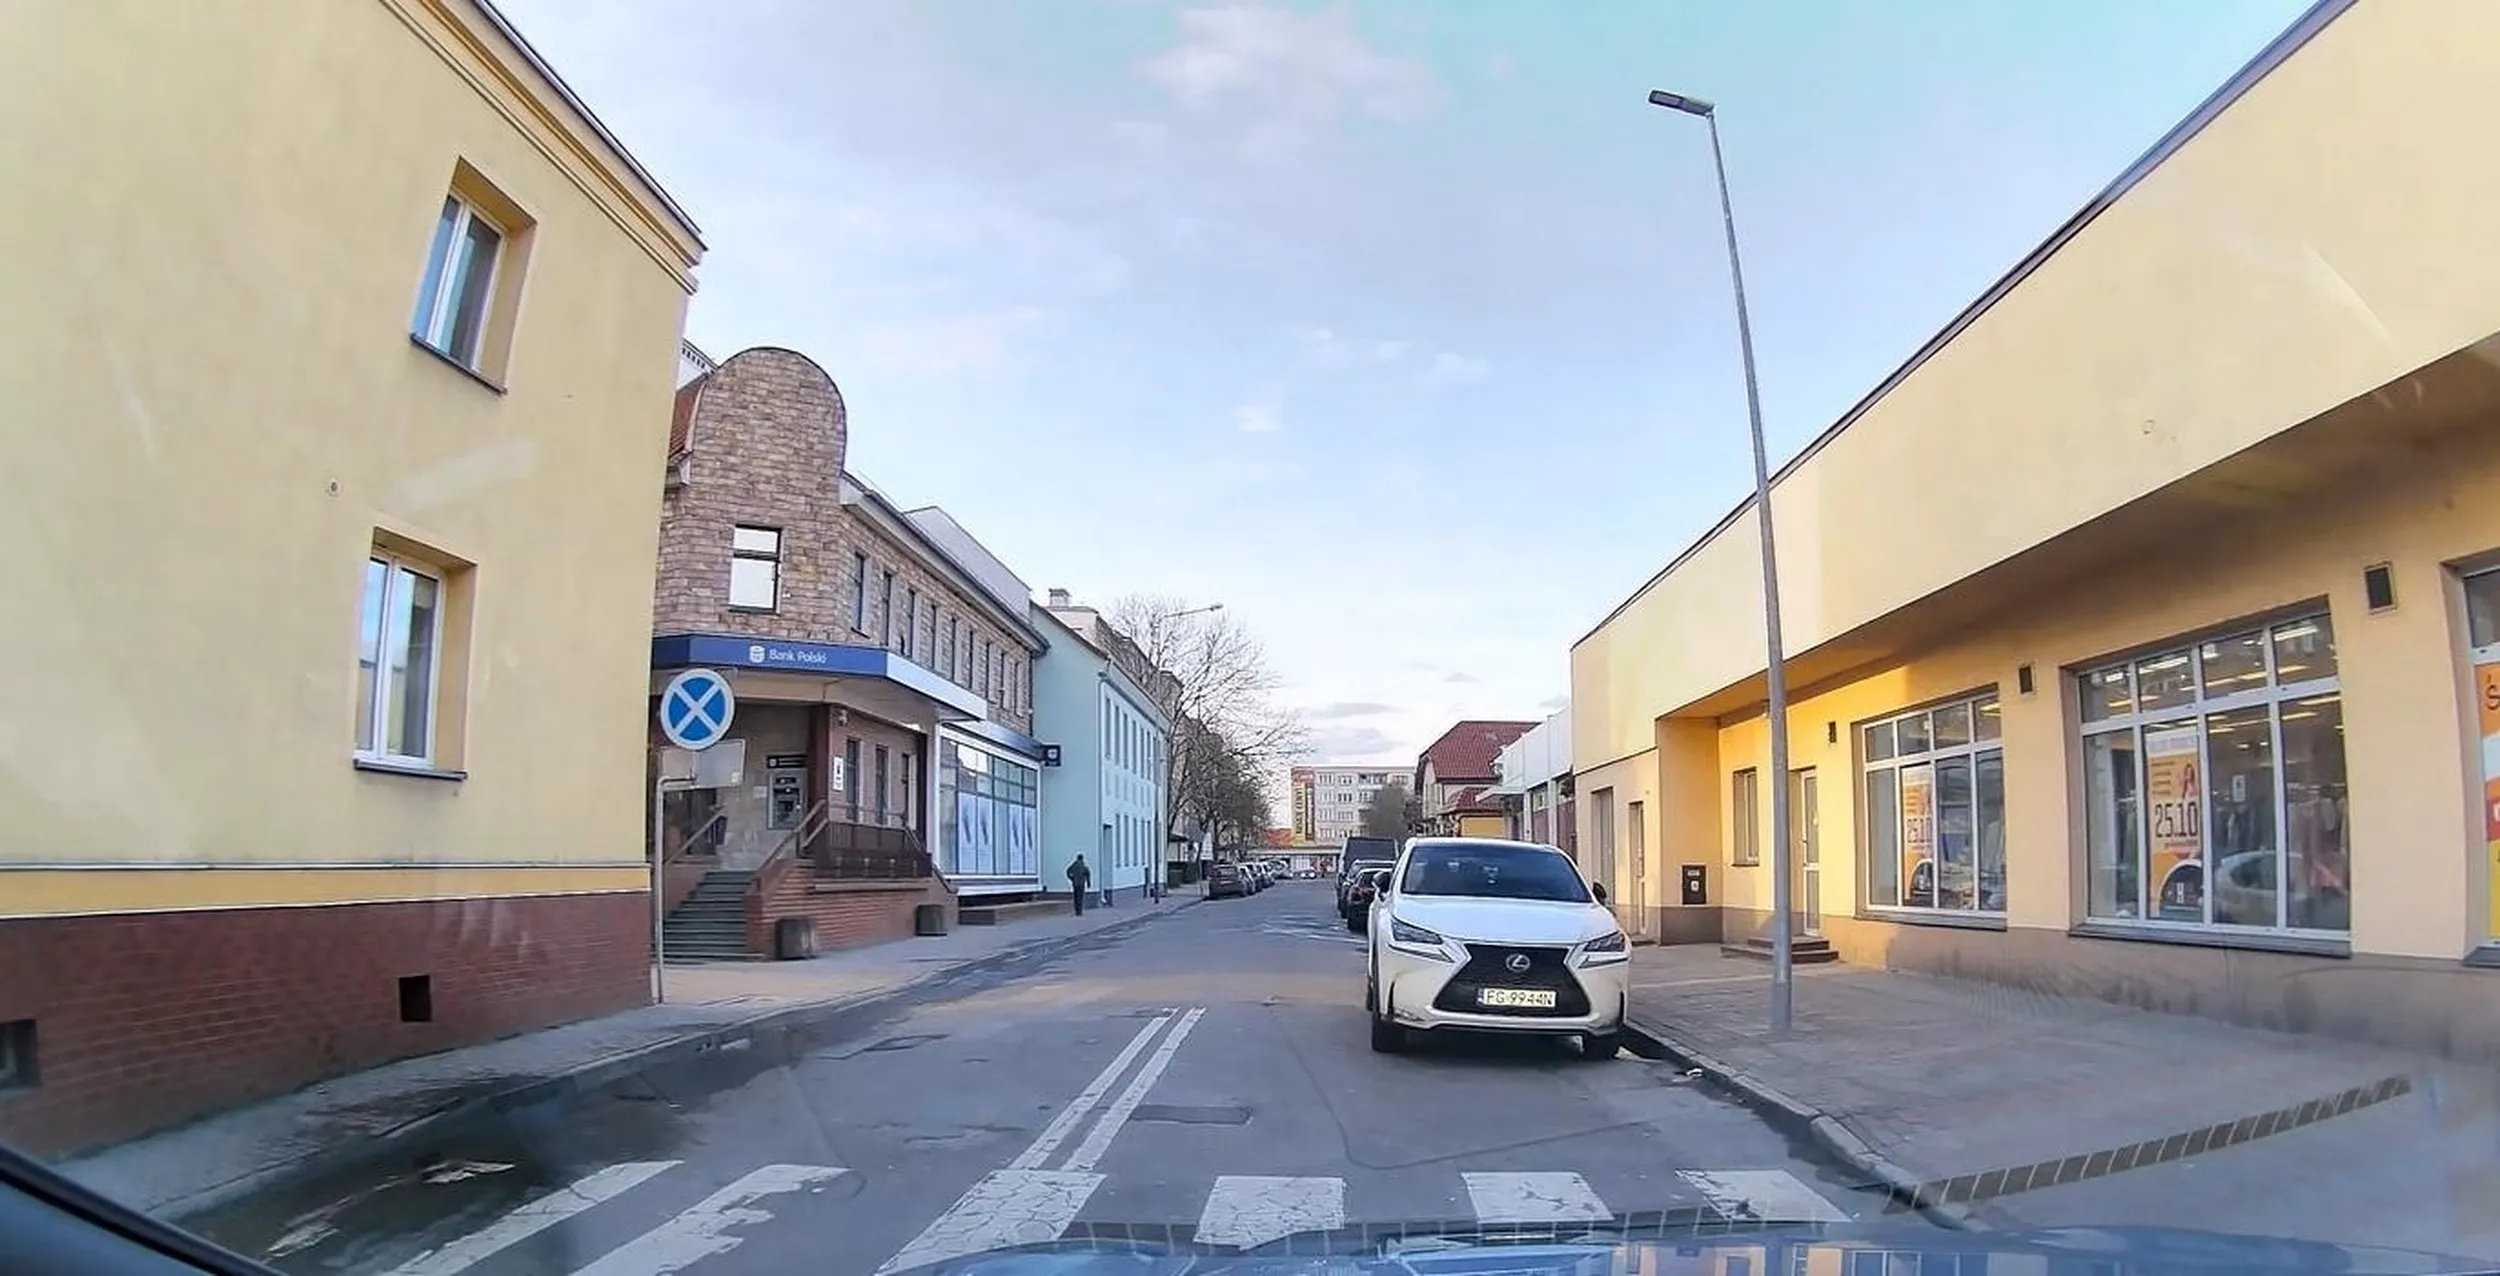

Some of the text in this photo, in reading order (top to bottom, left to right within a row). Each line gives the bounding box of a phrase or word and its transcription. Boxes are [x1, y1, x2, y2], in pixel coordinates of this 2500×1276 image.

[769, 648, 828, 664] Bank Polski
[2155, 801, 2197, 838] 25.10
[1487, 989, 1505, 1004] FG
[1510, 991, 1553, 1005] 9944N
